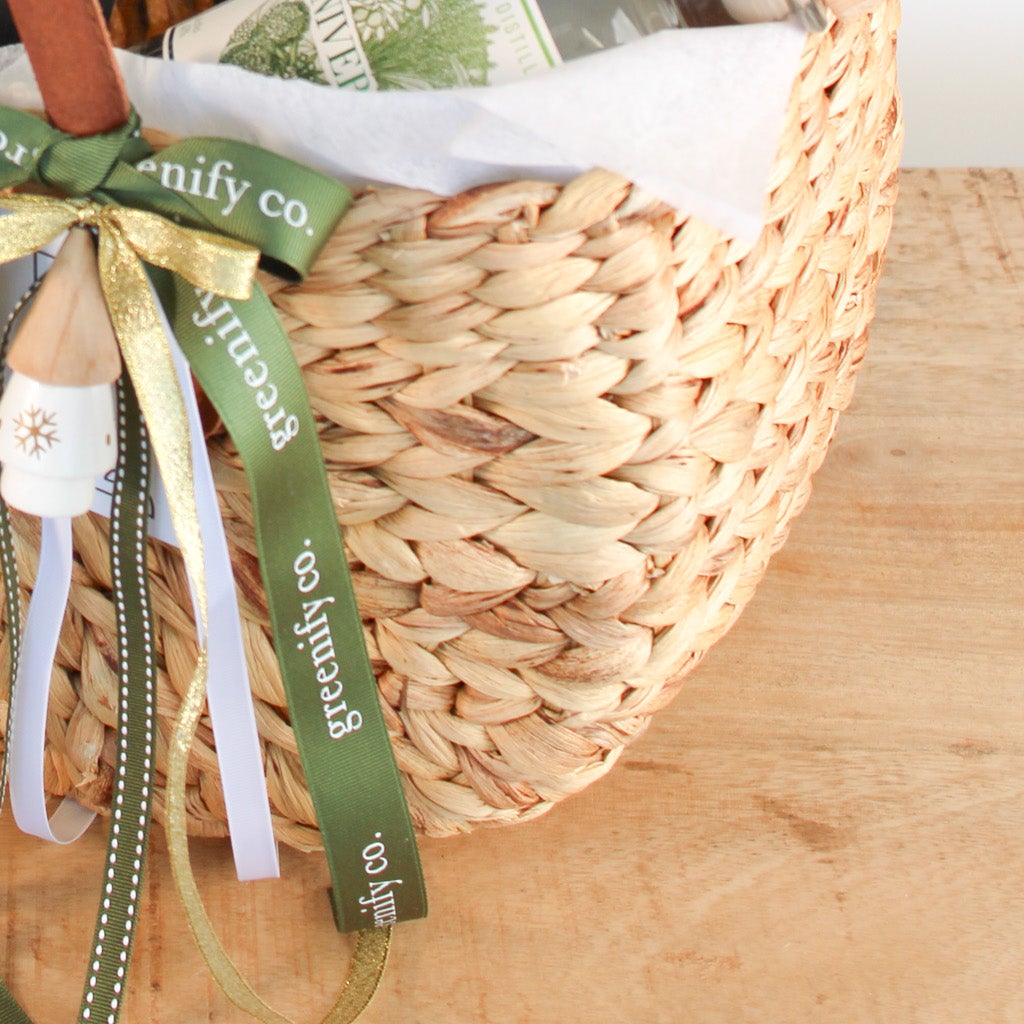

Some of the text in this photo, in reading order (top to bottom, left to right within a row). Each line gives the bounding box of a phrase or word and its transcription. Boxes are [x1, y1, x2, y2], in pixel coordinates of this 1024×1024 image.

[258, 188, 314, 237] co.
[293, 538, 364, 740] greenify co.
[362, 831, 389, 875] co.
